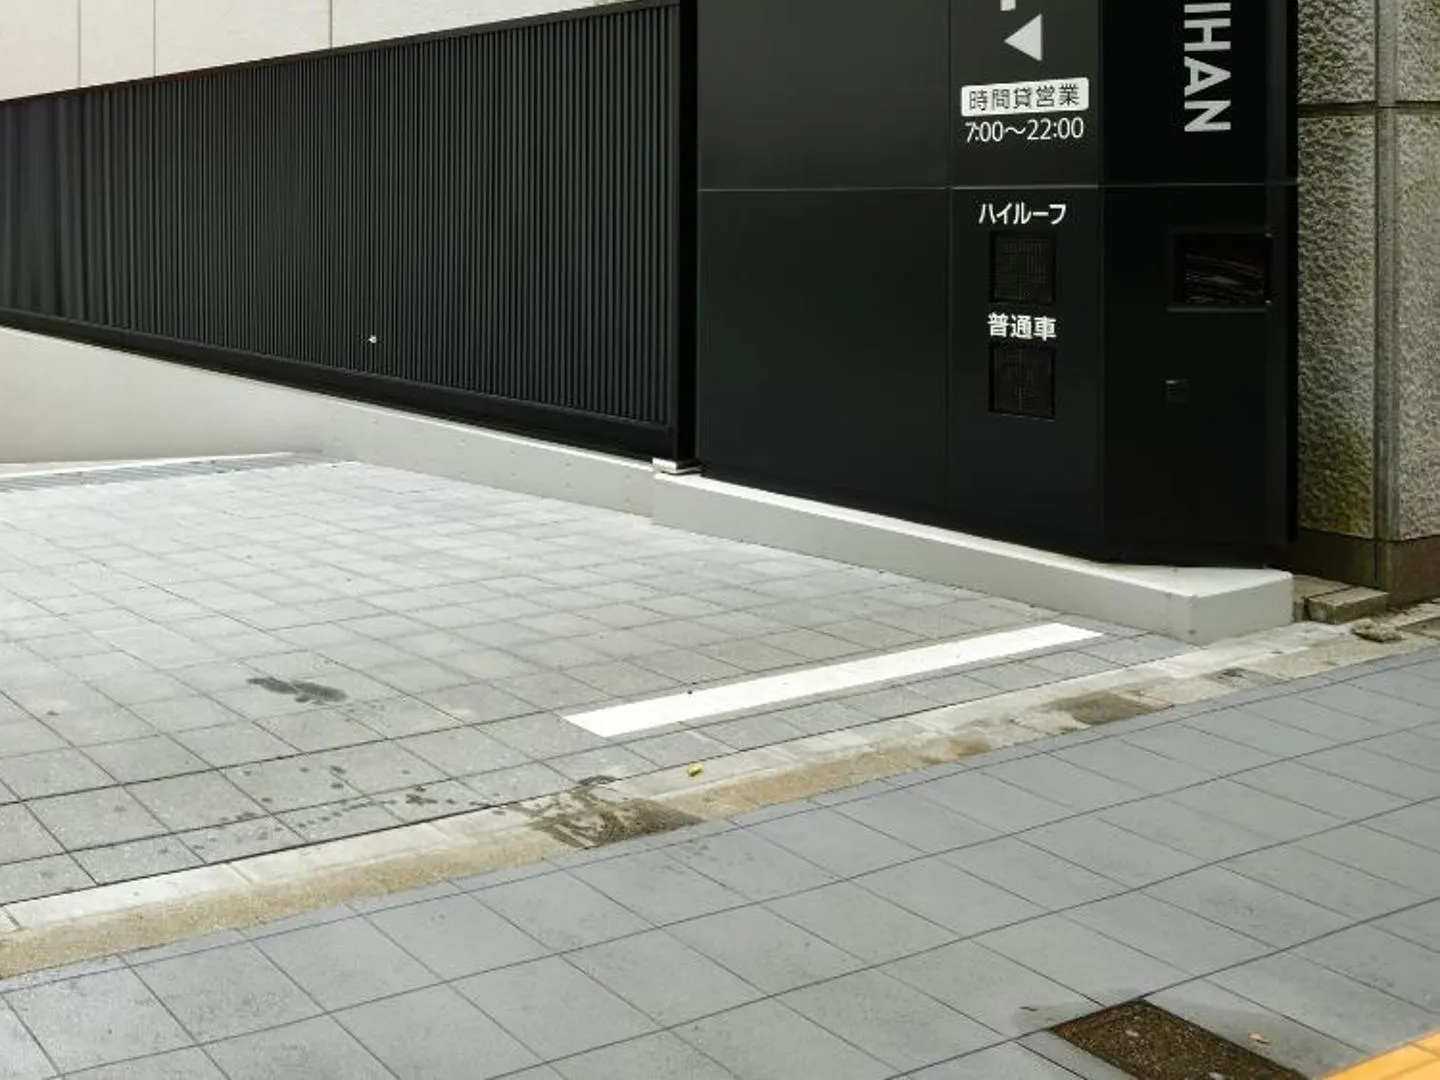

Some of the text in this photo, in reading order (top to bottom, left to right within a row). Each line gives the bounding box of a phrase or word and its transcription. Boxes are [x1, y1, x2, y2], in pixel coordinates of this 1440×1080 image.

[968, 83, 1080, 111] 時間貸営業
[978, 202, 1067, 225] ハイルーフ
[987, 312, 1057, 341] 普通車
